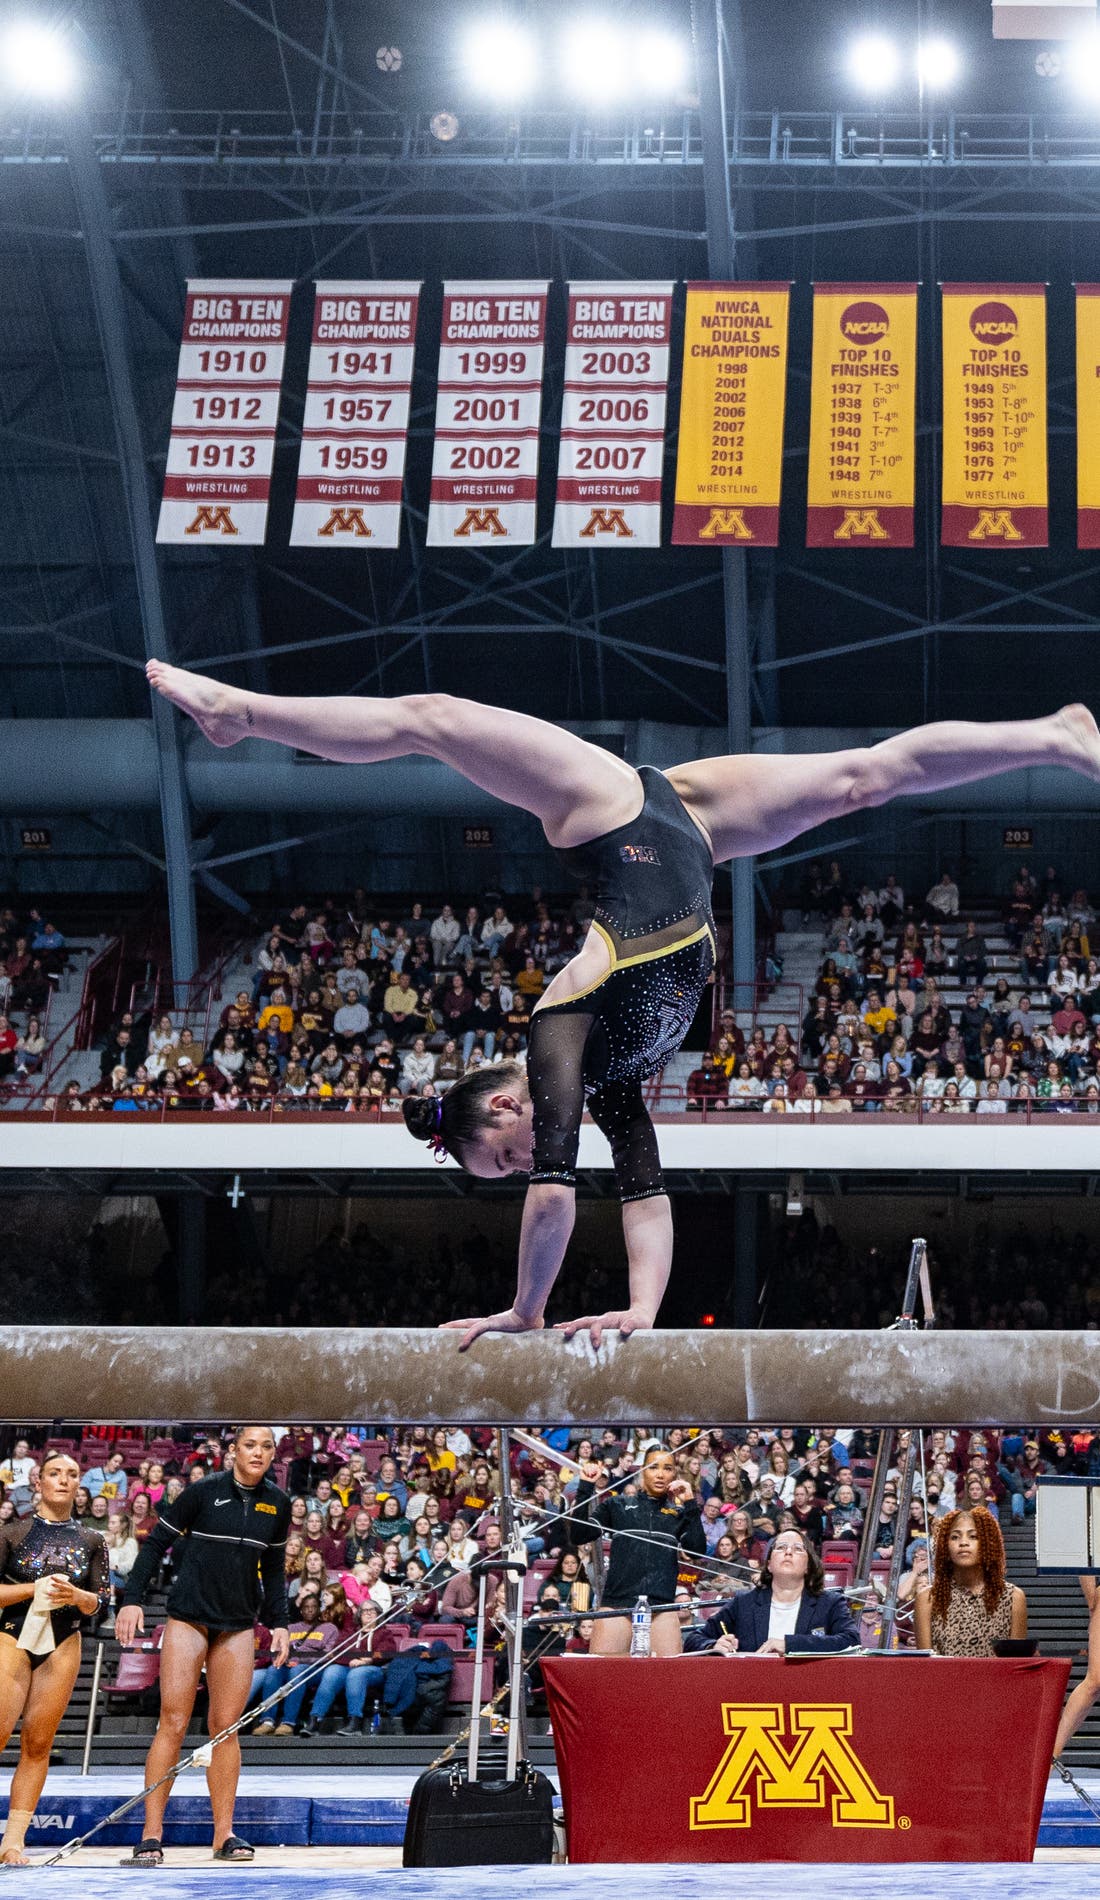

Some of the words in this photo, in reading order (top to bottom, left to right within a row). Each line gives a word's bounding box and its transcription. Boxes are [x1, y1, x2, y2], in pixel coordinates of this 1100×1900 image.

[192, 299, 233, 320] BIG
[240, 300, 283, 321] TEN
[321, 301, 361, 321] BIG
[367, 301, 411, 322] TEN
[450, 301, 490, 321] BIG
[495, 301, 540, 321] TEN
[575, 301, 615, 321] BIG
[620, 301, 665, 321] TEN
[715, 301, 760, 313] NWCA
[701, 316, 773, 328] NATIONAL
[844, 321, 888, 335] NCAA
[974, 322, 1017, 335] NCAA
[188, 323, 281, 338] CHAMPIONS
[317, 325, 410, 339] CHAMPIONS
[447, 325, 539, 339] CHAMPIONS
[572, 325, 665, 339] CHAMPIONS
[712, 330, 760, 343] DUALS
[691, 344, 780, 358] CHAMPIONS
[839, 349, 867, 362] TOP
[873, 349, 892, 362] 10
[970, 349, 997, 362] TOP
[1003, 350, 1021, 362] 10
[198, 351, 267, 373] 1910
[328, 352, 392, 375] 1941
[458, 352, 526, 375] 1999
[582, 352, 651, 375] 2003
[717, 363, 748, 374] 1998
[831, 364, 899, 377] FINISHES
[962, 364, 1029, 378] FINISHES
[715, 377, 746, 388] 2001
[831, 383, 862, 394] 1937
[964, 383, 994, 394] 1949
[714, 391, 746, 403] 2002
[831, 397, 862, 409] 1938
[964, 397, 994, 409] 1953
[192, 397, 261, 420] 1912
[323, 398, 392, 422] 1957
[453, 399, 520, 421] 2001
[579, 399, 649, 422] 2006
[714, 406, 746, 418] 2006
[831, 412, 862, 423] 1939
[713, 421, 745, 432] 2007
[830, 426, 861, 438] 1940
[964, 426, 994, 438] 1959
[712, 435, 744, 447] 2012
[830, 441, 859, 452] 1941
[964, 440, 994, 452] 1963
[187, 445, 256, 467] 1913
[318, 445, 388, 470] 1959
[450, 447, 521, 470] 2002
[575, 447, 646, 470] 2007
[711, 450, 744, 462] 2013
[829, 455, 860, 467] 1947
[964, 455, 994, 467] 1976
[710, 465, 743, 477] 2014
[829, 470, 860, 481] 1948
[964, 470, 994, 482] 1977
[186, 482, 247, 494] WRESTLING
[318, 484, 380, 495] WRESTLING
[453, 484, 514, 495] WRESTLING
[578, 484, 639, 495] WRESTLING
[697, 484, 758, 494] WRESTLING
[831, 490, 893, 499] WRESTLING
[965, 490, 1025, 500] WRESTLING
[184, 506, 239, 535] M
[317, 508, 372, 537] M
[454, 508, 508, 537] M
[579, 508, 633, 538] M
[699, 509, 752, 539] M
[834, 509, 888, 539] M
[968, 511, 1022, 540] M
[23, 831, 46, 843] 201
[465, 830, 490, 841] 202
[1005, 831, 1030, 842] 203
[689, 1703, 895, 1830] M
